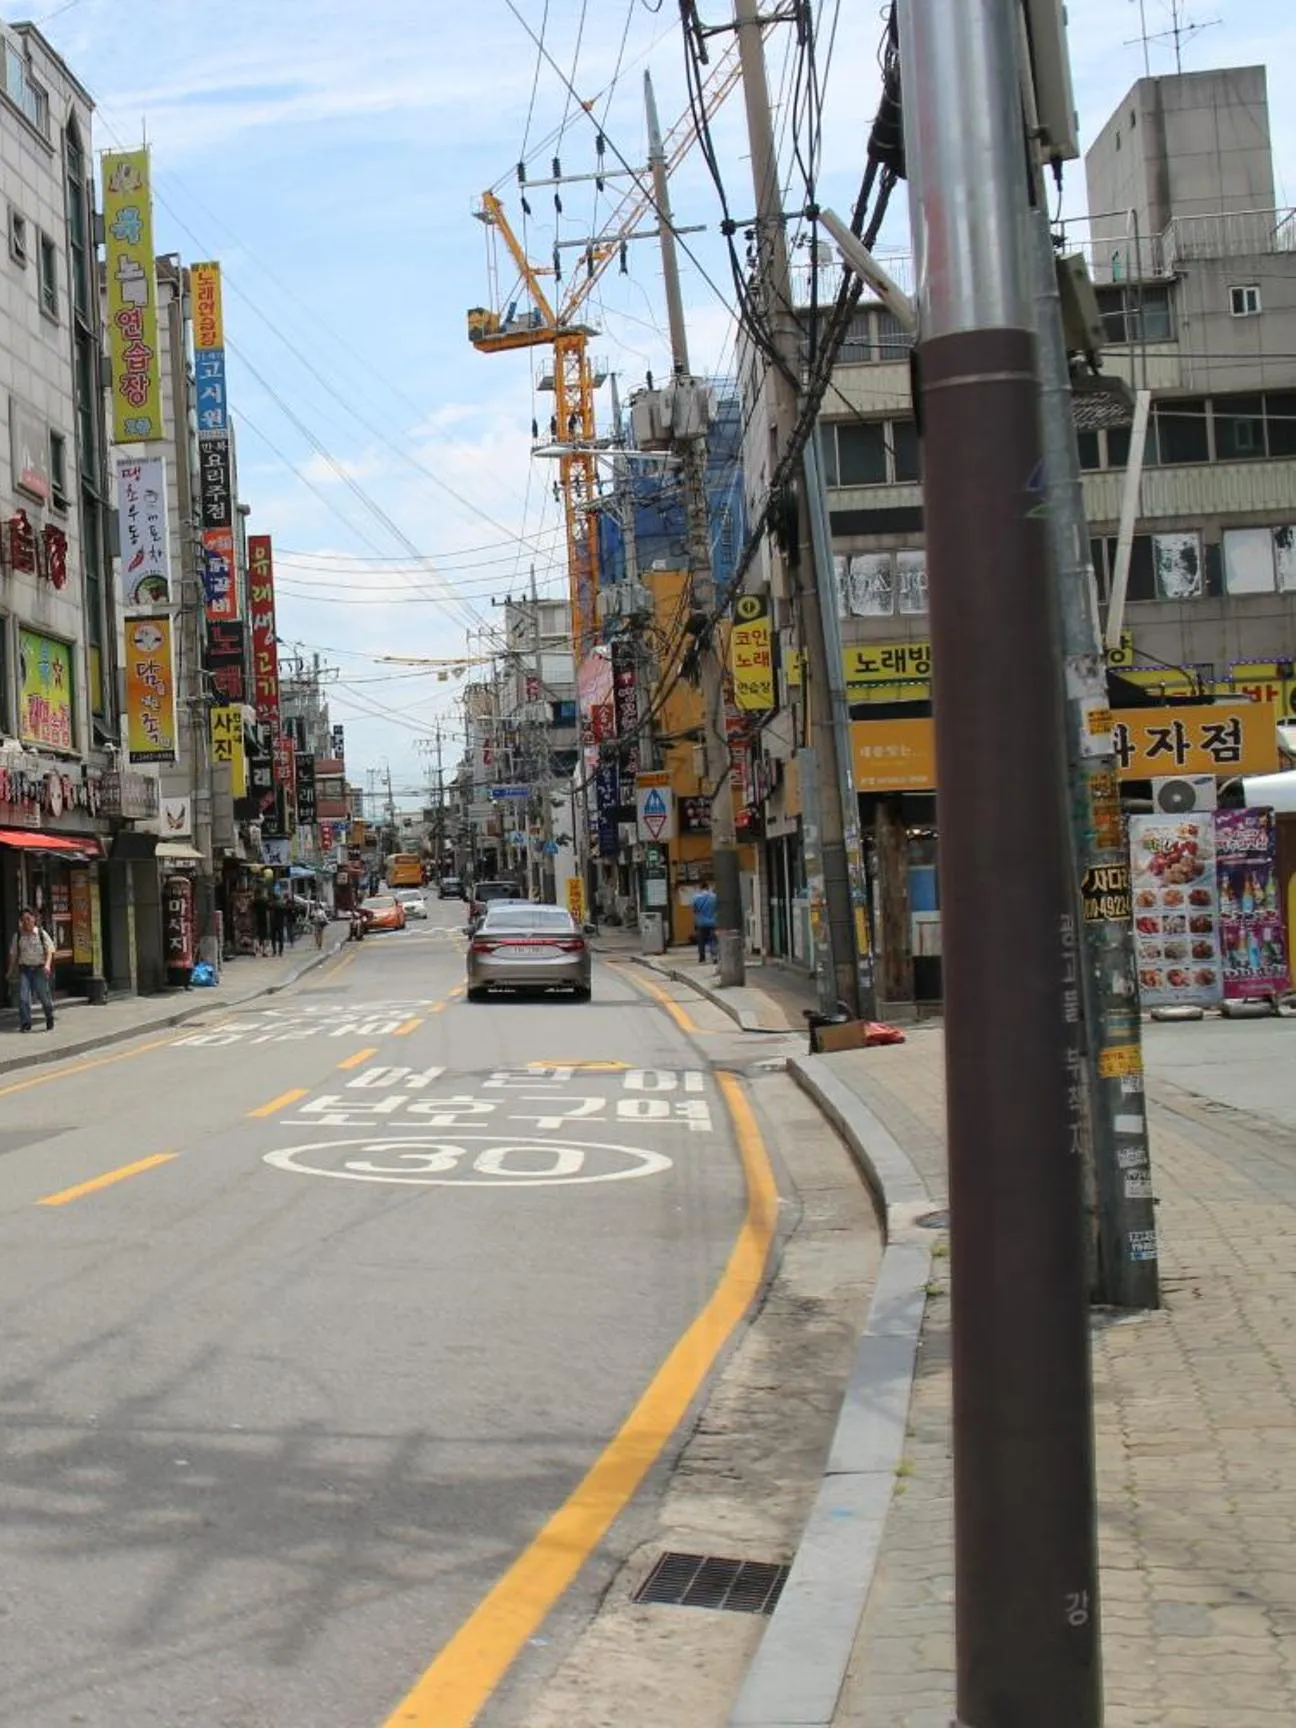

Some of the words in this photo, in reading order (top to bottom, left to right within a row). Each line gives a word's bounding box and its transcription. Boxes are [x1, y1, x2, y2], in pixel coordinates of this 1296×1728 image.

[735, 629, 768, 647] 코인
[736, 650, 770, 669] 노래
[855, 646, 931, 674] 노래방
[737, 680, 771, 696] 연습장
[213, 712, 233, 762] 사진
[345, 1066, 704, 1092] 어린이
[280, 1093, 712, 1132] 보호구역
[344, 1143, 586, 1177] 30
[1065, 1589, 1089, 1625] 강
